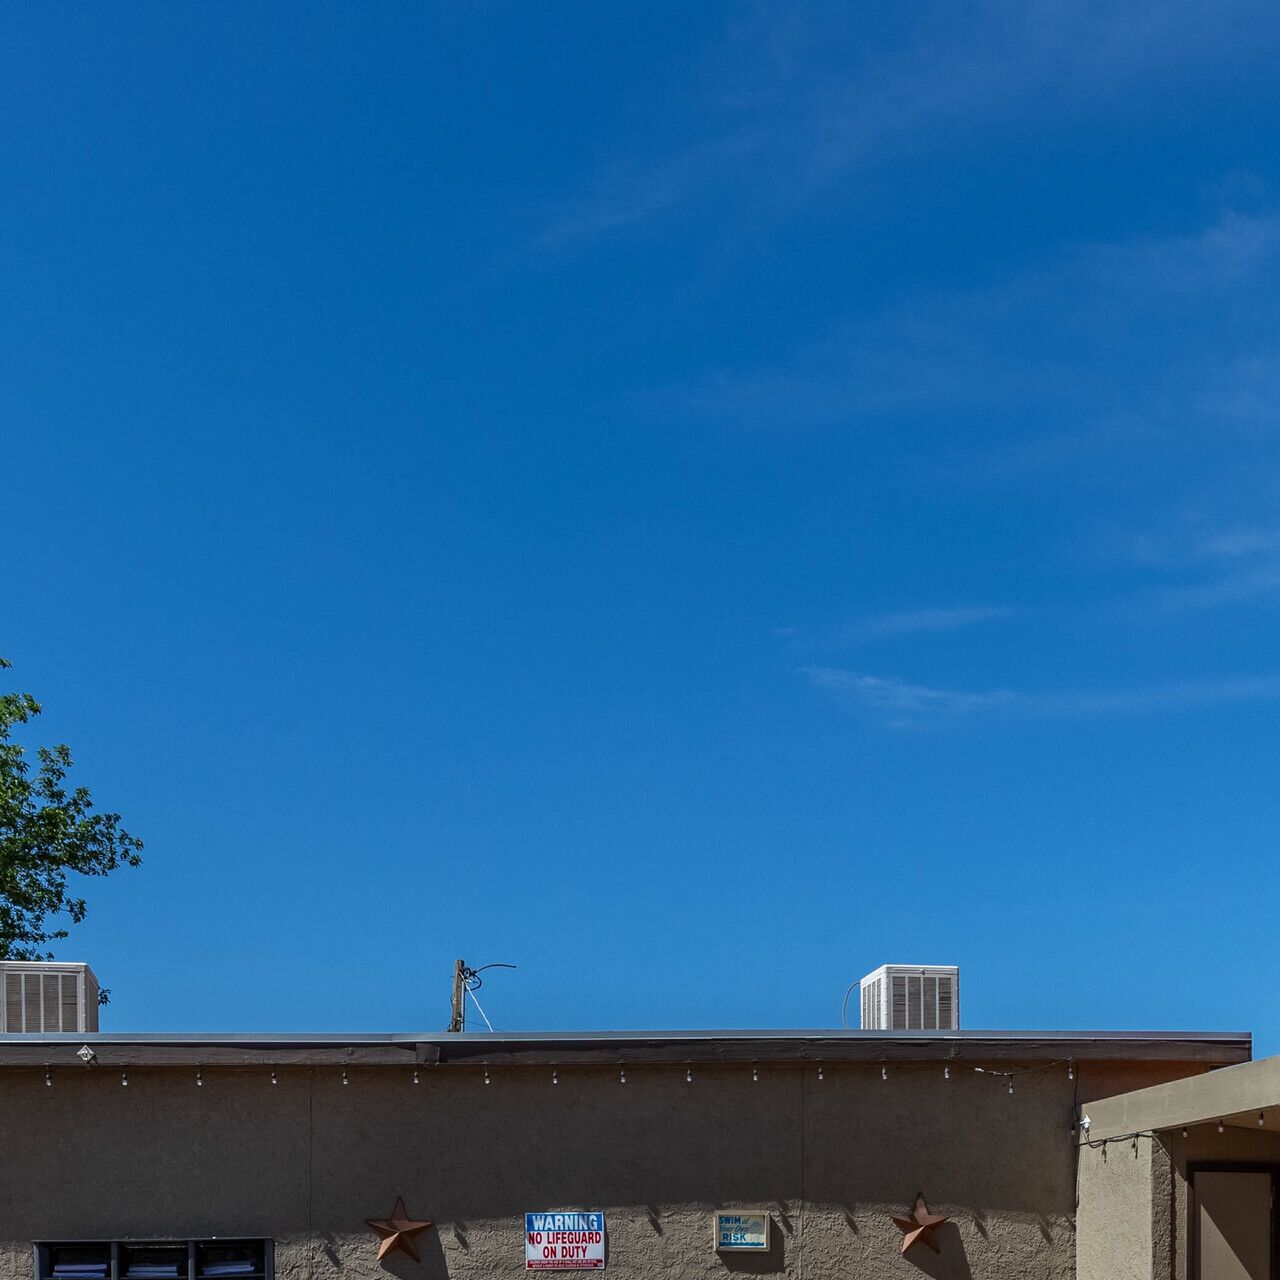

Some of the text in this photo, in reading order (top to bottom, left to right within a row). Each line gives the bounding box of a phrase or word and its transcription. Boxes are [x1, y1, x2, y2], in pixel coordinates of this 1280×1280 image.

[532, 1214, 598, 1231] WARNING
[719, 1216, 741, 1224] SWIM
[528, 1232, 601, 1245] NO LIFEGUARD
[722, 1233, 747, 1241] RISK
[543, 1246, 588, 1259] ON DUTY
